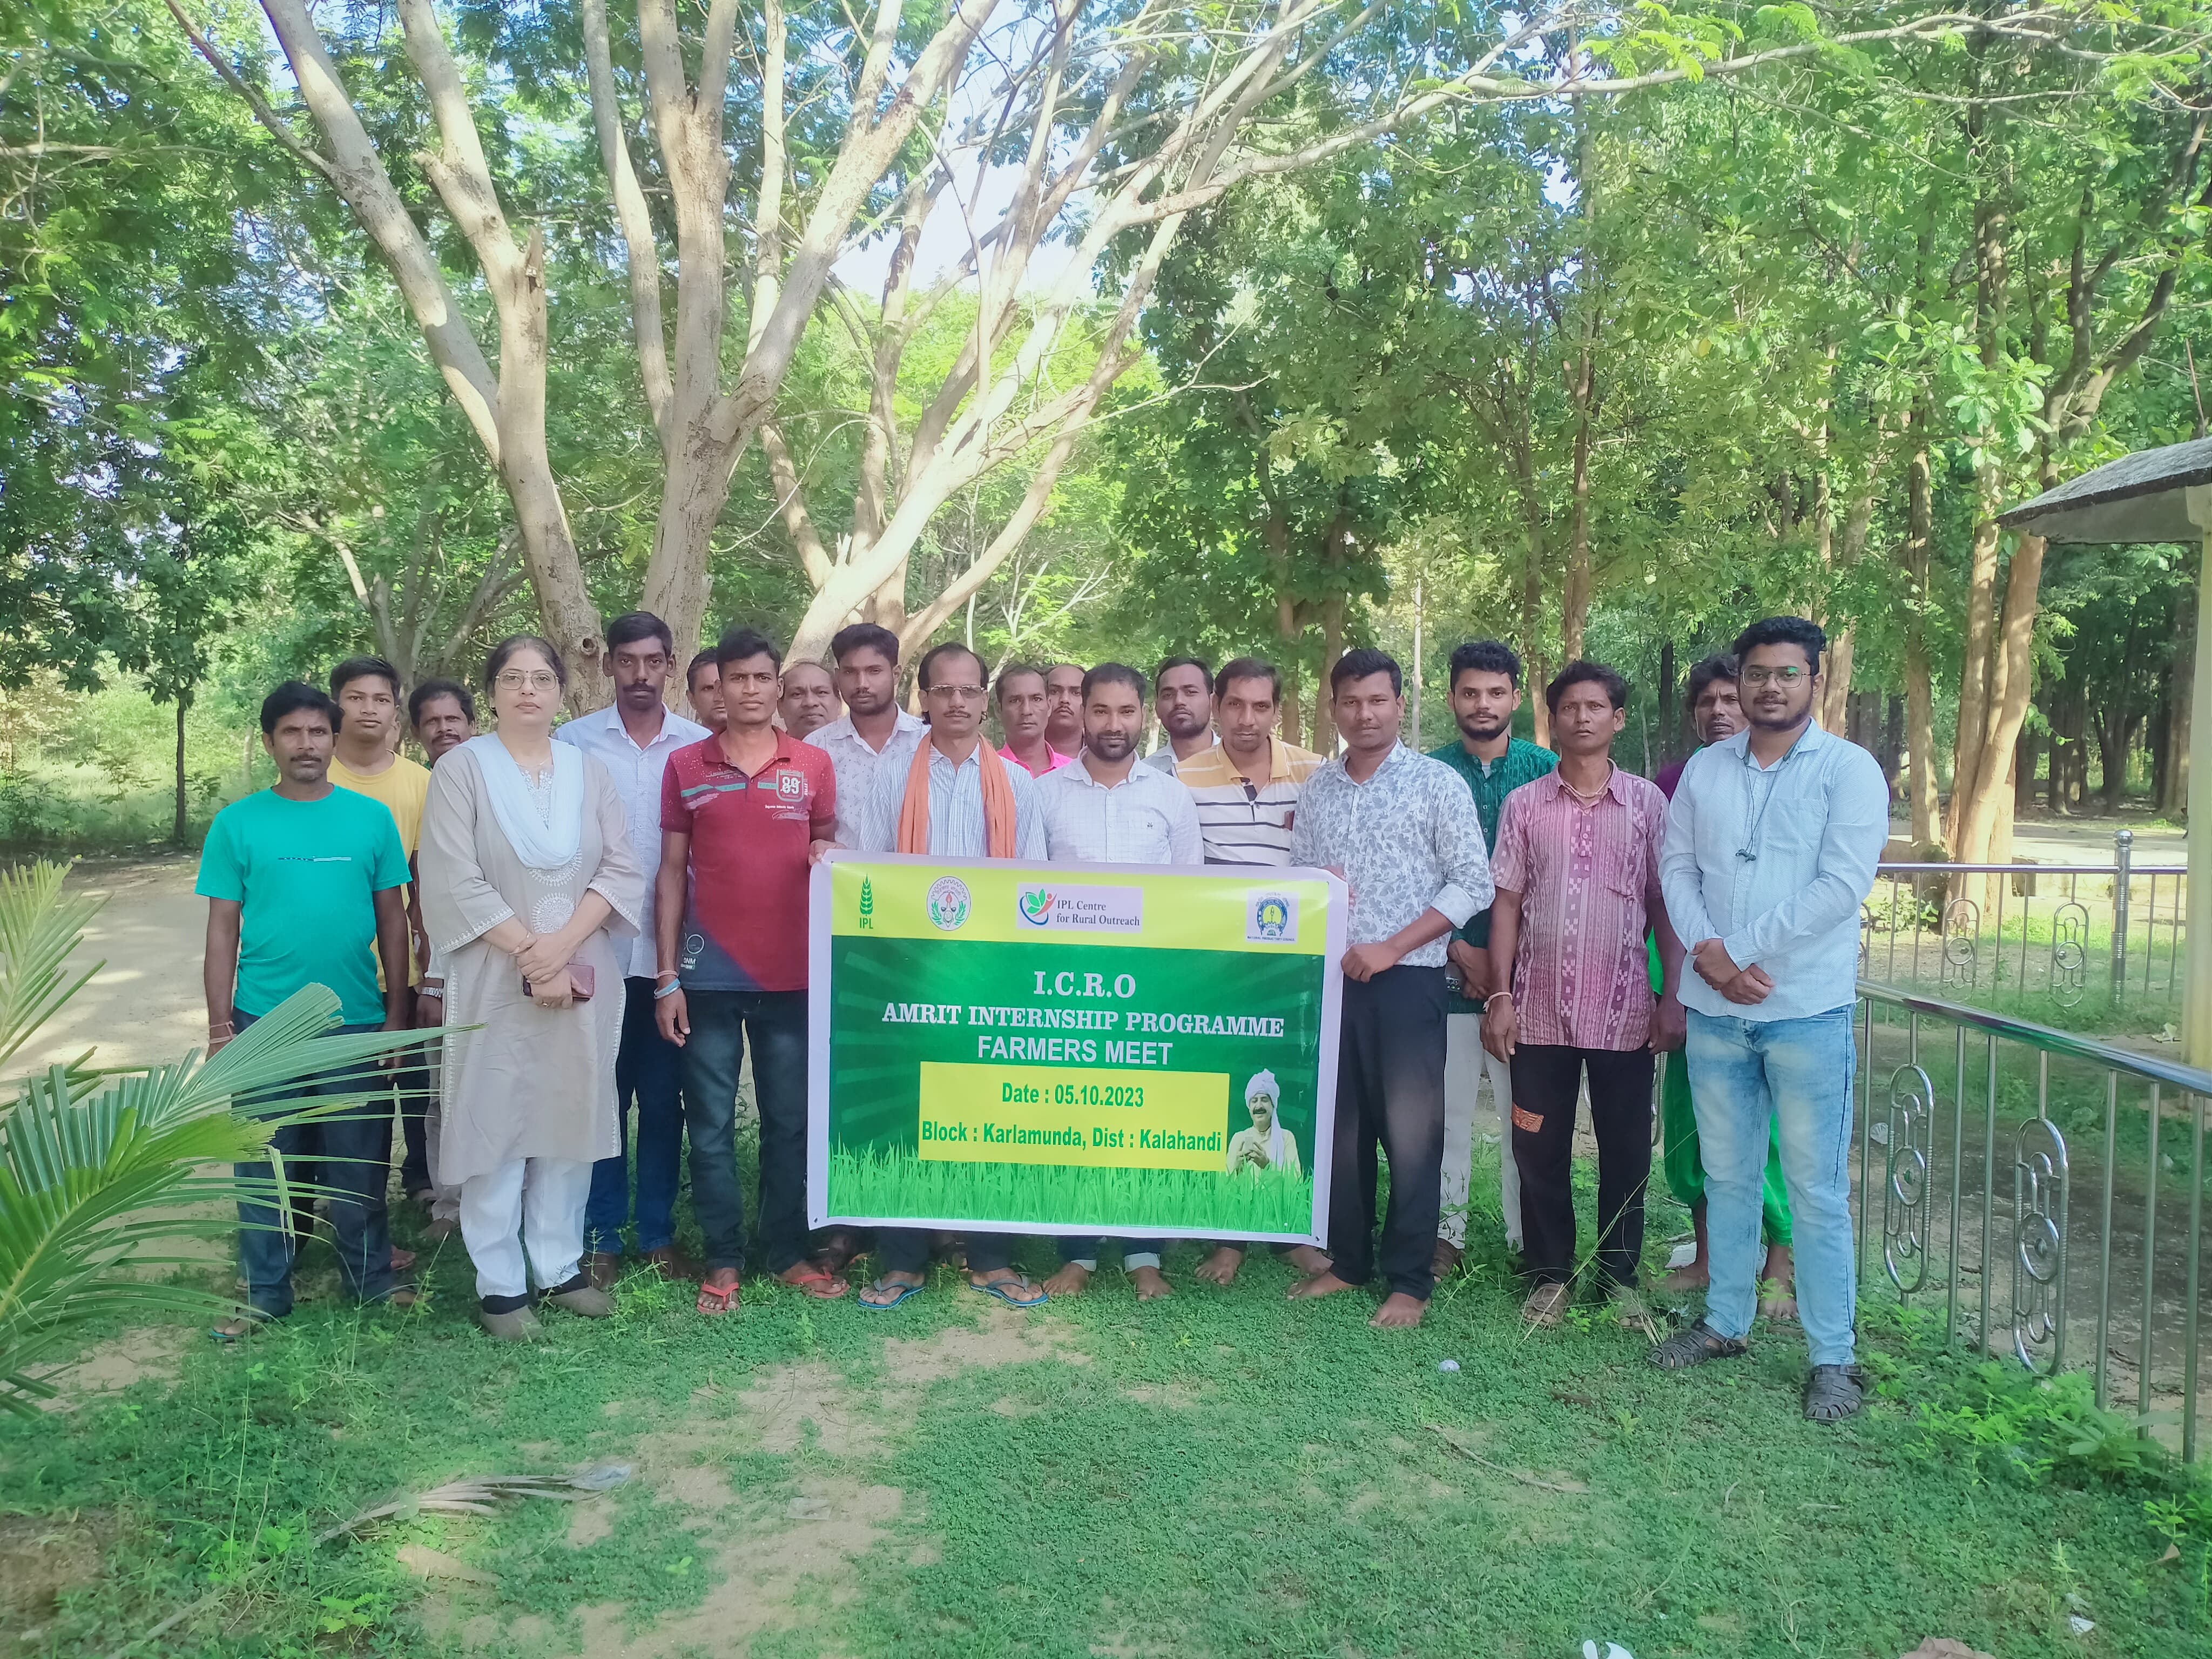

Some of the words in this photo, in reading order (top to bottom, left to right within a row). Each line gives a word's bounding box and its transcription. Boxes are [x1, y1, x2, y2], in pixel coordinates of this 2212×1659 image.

[1057, 900, 1074, 910] IPL
[1076, 900, 1106, 911] Centre
[859, 917, 874, 929] IPL
[1056, 913, 1069, 923] for
[1072, 913, 1096, 924] Rural
[1099, 915, 1140, 926] Outreach
[1034, 971, 1136, 998] I.C.R.O
[882, 1002, 962, 1024] AMRIT
[968, 1006, 1118, 1030] INTERNSHIP
[1125, 1012, 1284, 1037] PROGRAMME
[978, 1035, 1097, 1062] FARMERS
[1105, 1040, 1173, 1065] MEET
[1002, 1082, 1039, 1103] Date
[1055, 1084, 1144, 1108] 05.10.2023
[922, 1121, 967, 1142] Block
[983, 1123, 1086, 1151] Karlamunda,
[1092, 1127, 1124, 1148] Dist
[1140, 1129, 1221, 1152] Kalahandi
